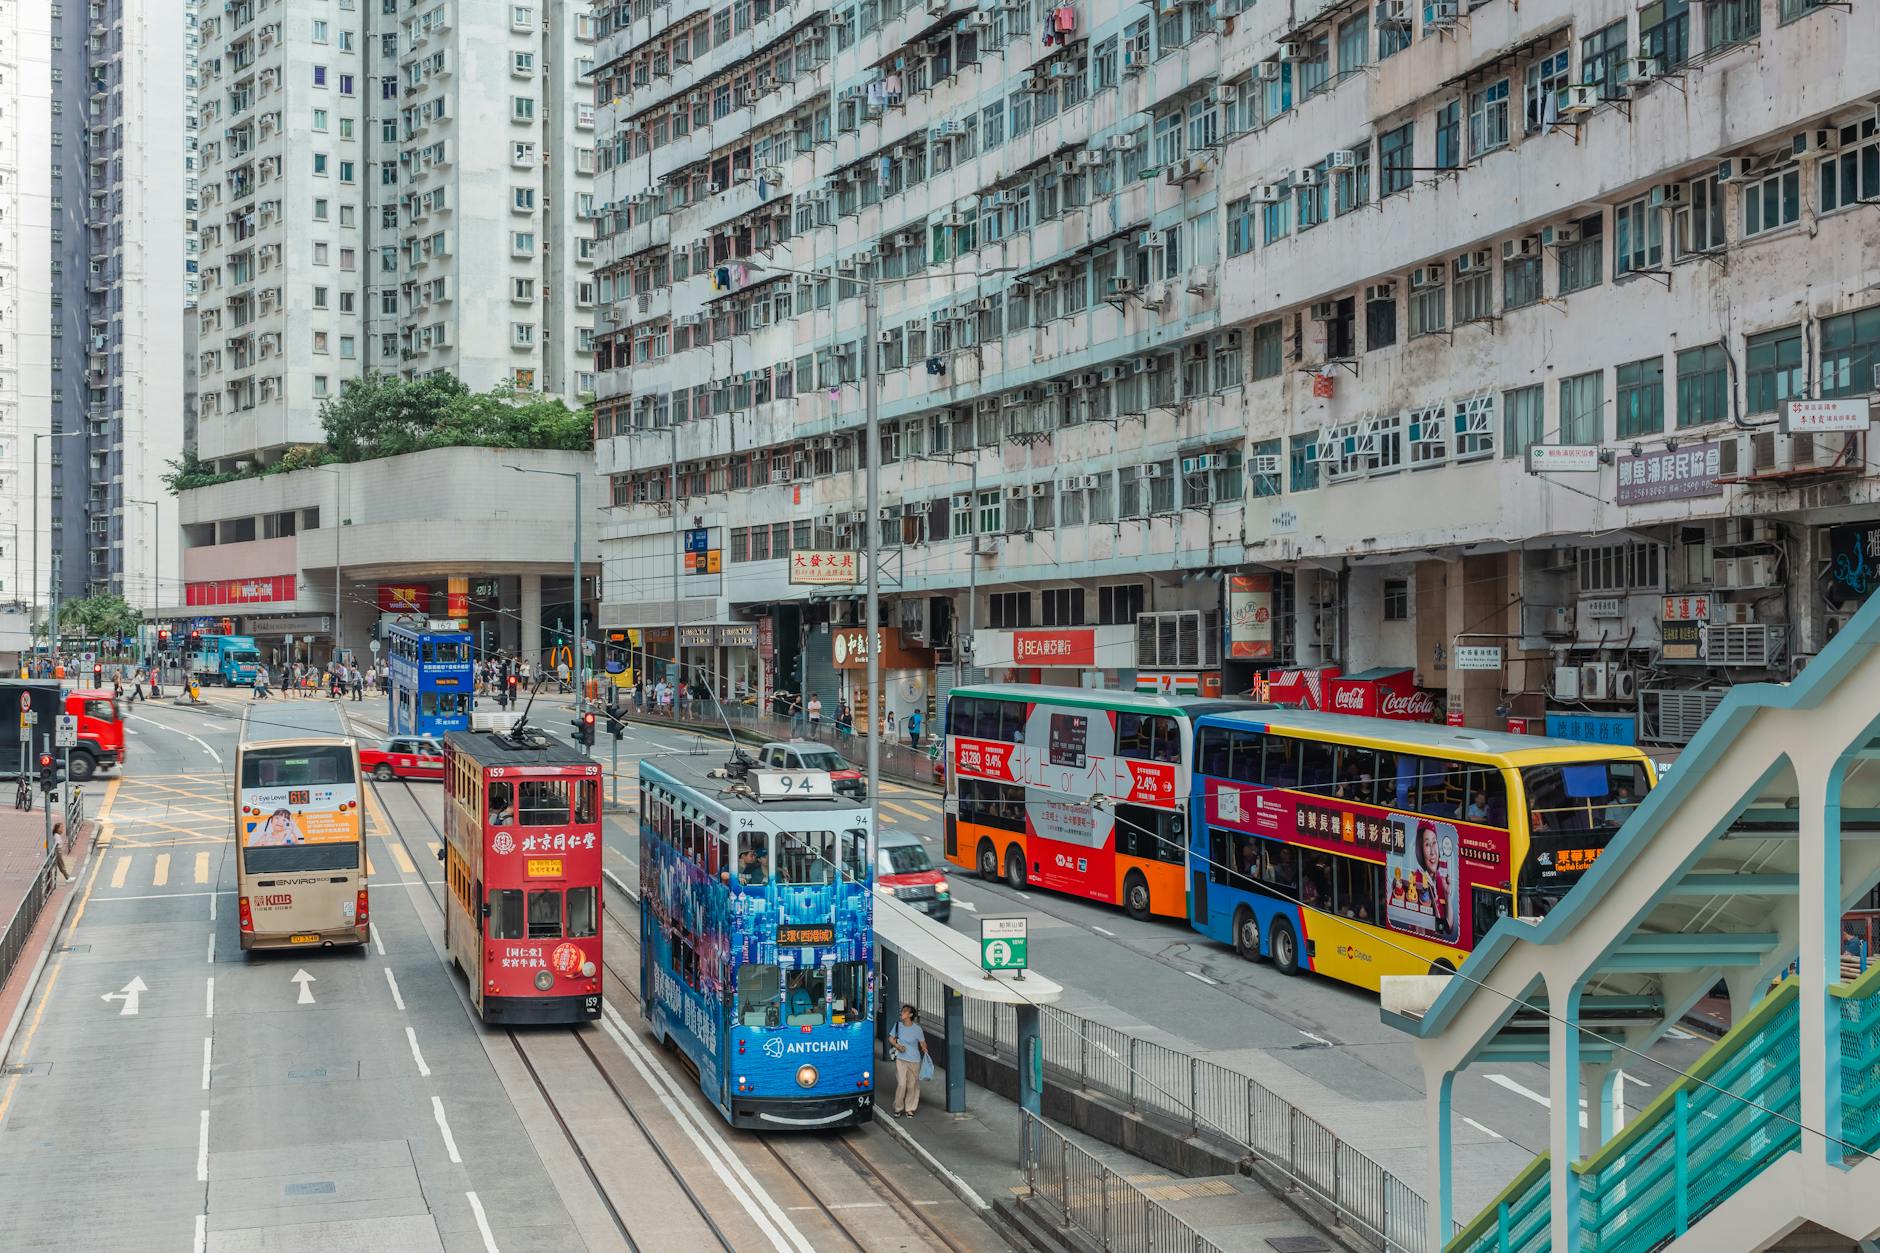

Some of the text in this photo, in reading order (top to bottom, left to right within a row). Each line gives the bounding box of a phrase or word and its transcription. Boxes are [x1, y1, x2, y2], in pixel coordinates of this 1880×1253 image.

[795, 554, 853, 567] 大發文具
[1025, 639, 1071, 655] BEA 東亞銀行
[1335, 687, 1365, 709] Coca-Cola
[1382, 691, 1434, 714] Coca-Cola
[985, 753, 1002, 768] 9.4%
[490, 768, 504, 777] 159
[586, 766, 598, 776] 159
[781, 776, 814, 792] 94
[1137, 775, 1157, 792] 2.4%
[290, 791, 308, 804] 613
[740, 818, 754, 828] 94
[856, 815, 868, 825] 94
[1297, 809, 1341, 834] 自製長糧
[1356, 820, 1404, 848] 精彩起飛
[522, 832, 596, 852] 北京同仁堂
[266, 894, 292, 906] KMB
[586, 997, 598, 1006] 159
[787, 1039, 849, 1053] ANTCHAIN
[858, 1096, 870, 1106] 94
